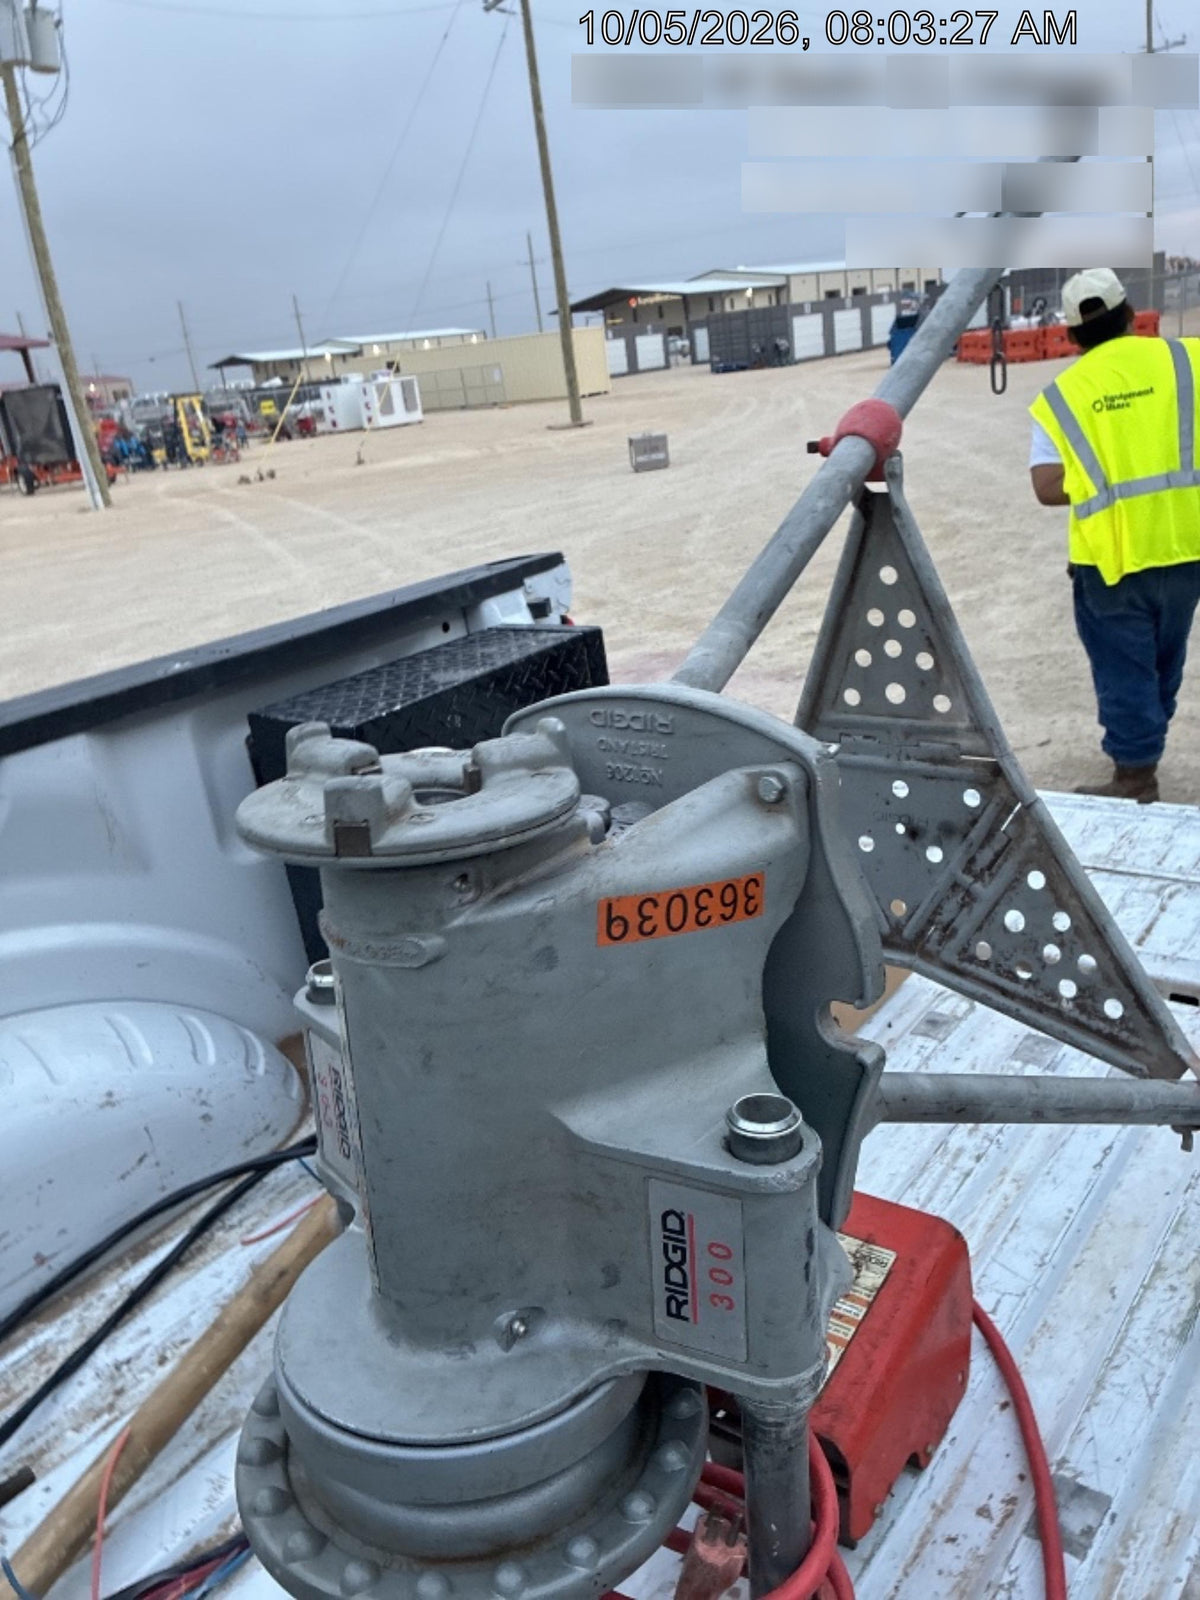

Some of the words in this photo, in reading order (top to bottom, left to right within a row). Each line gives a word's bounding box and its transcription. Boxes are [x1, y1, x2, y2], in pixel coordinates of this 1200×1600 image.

[1103, 386, 1154, 404] Equipment
[589, 708, 675, 735] RIDGID
[606, 877, 761, 942] 363039
[661, 1208, 690, 1322] RIDGID
[707, 1241, 736, 1312] 300
